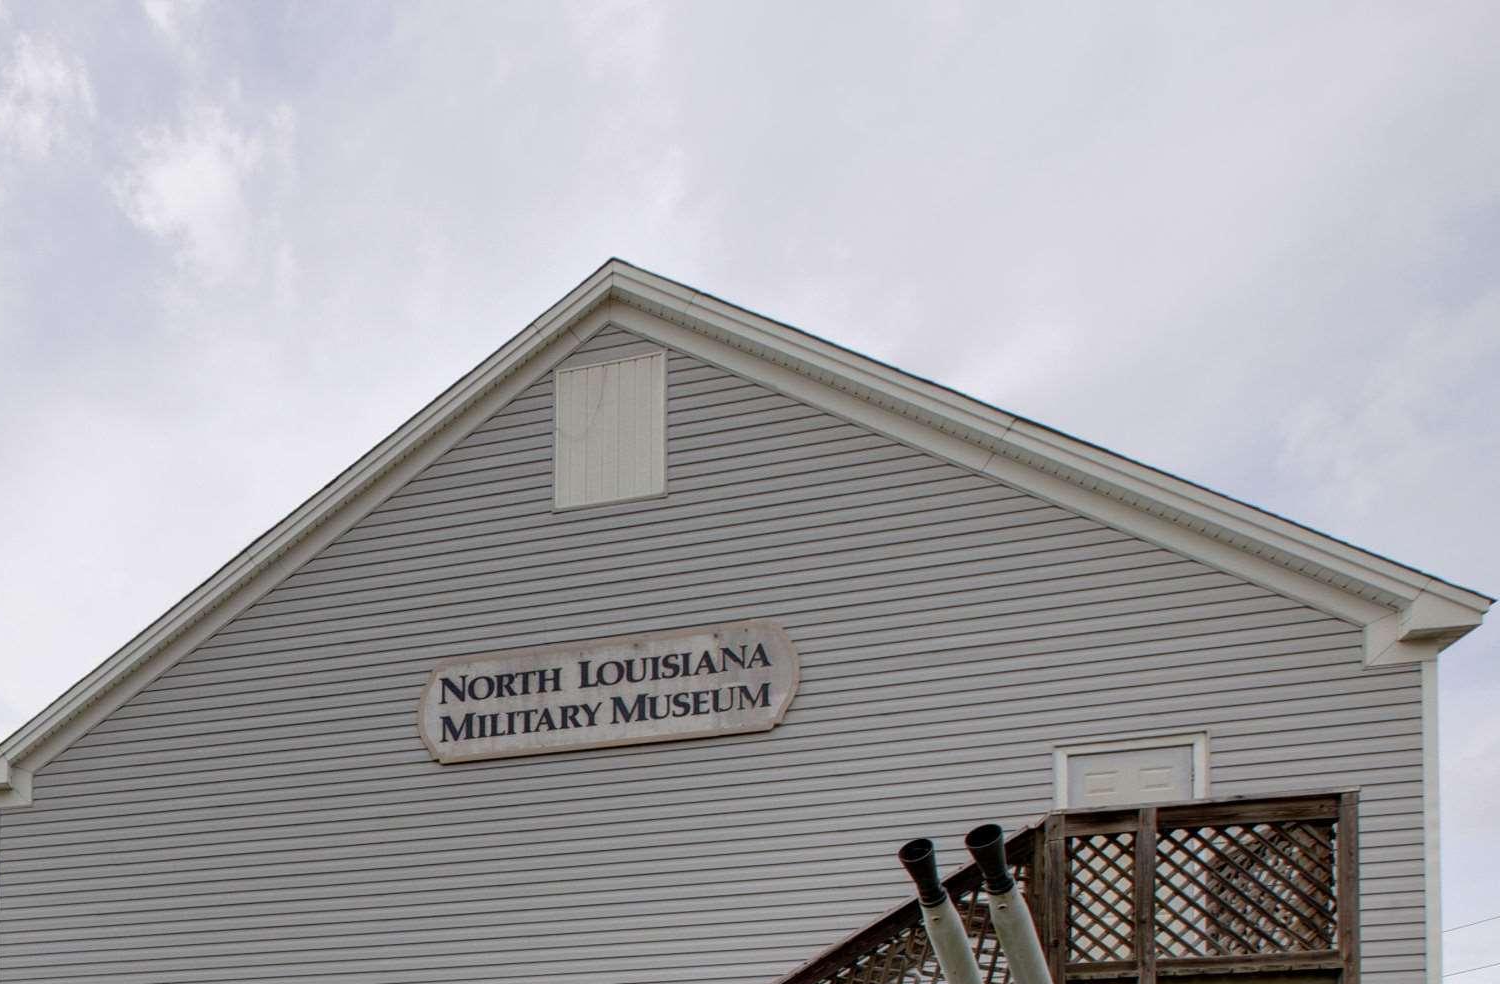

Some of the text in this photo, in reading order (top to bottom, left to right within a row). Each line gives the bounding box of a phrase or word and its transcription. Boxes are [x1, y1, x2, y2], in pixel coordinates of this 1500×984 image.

[440, 643, 772, 705] NORTH LOUISIANA
[439, 682, 772, 743] MILITARY MUSEUM
